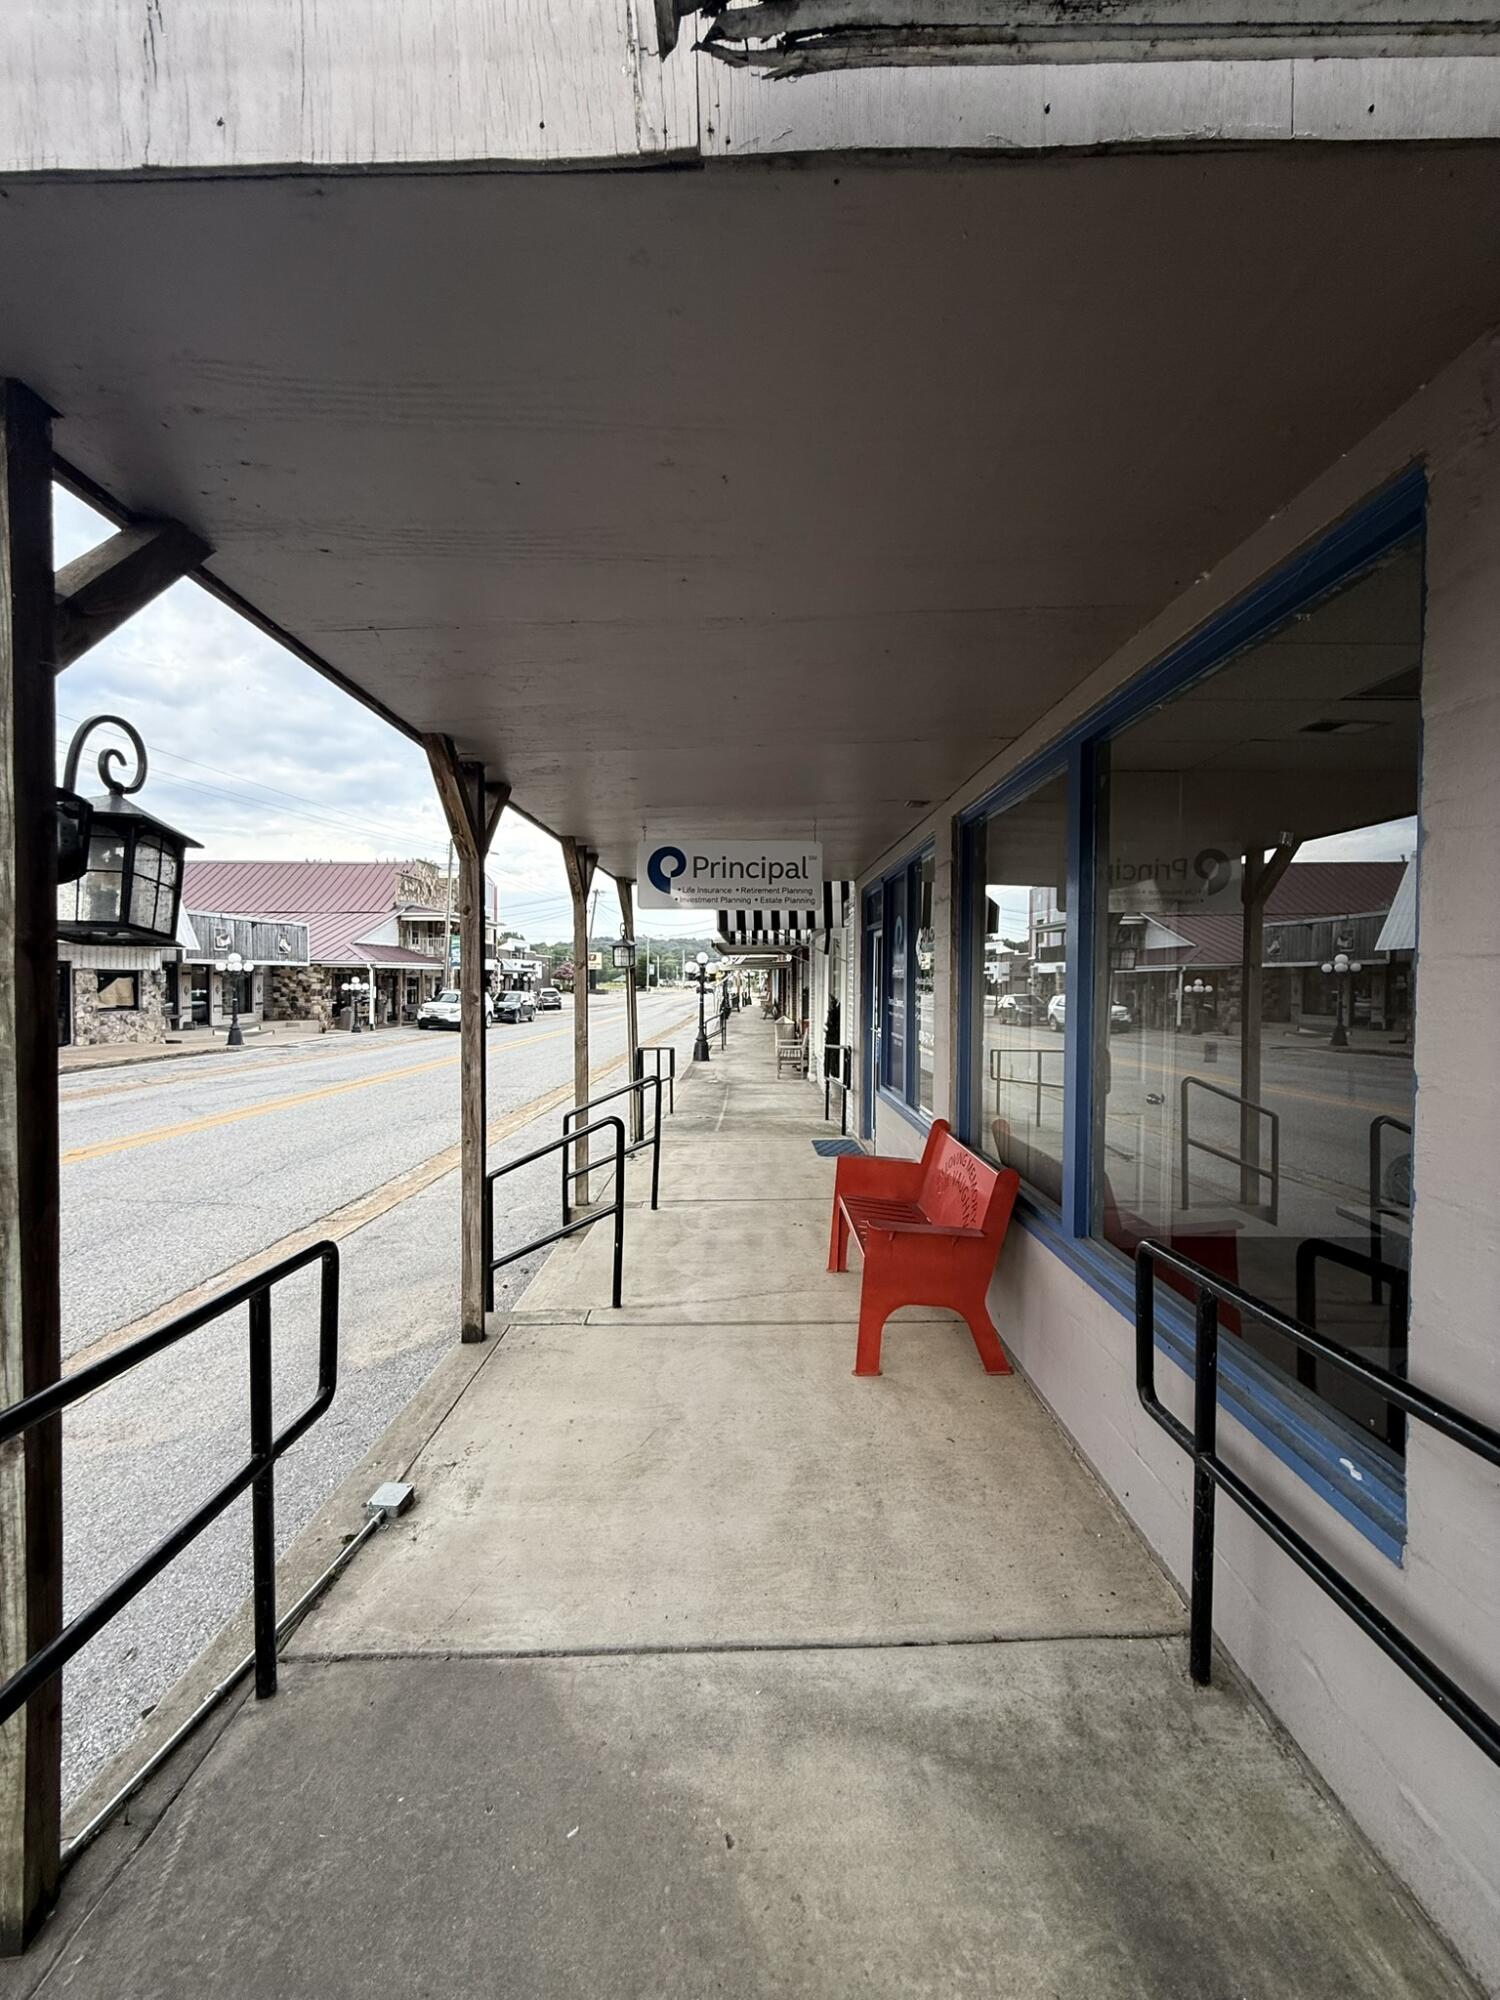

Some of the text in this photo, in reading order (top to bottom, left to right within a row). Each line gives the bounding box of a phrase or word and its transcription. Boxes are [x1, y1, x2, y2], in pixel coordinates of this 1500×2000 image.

[693, 855, 809, 885] Principal
[682, 886, 733, 894] Life Insurance
[740, 887, 814, 897] Retirement Planning
[720, 896, 752, 905] Planning
[784, 897, 816, 906] Planning
